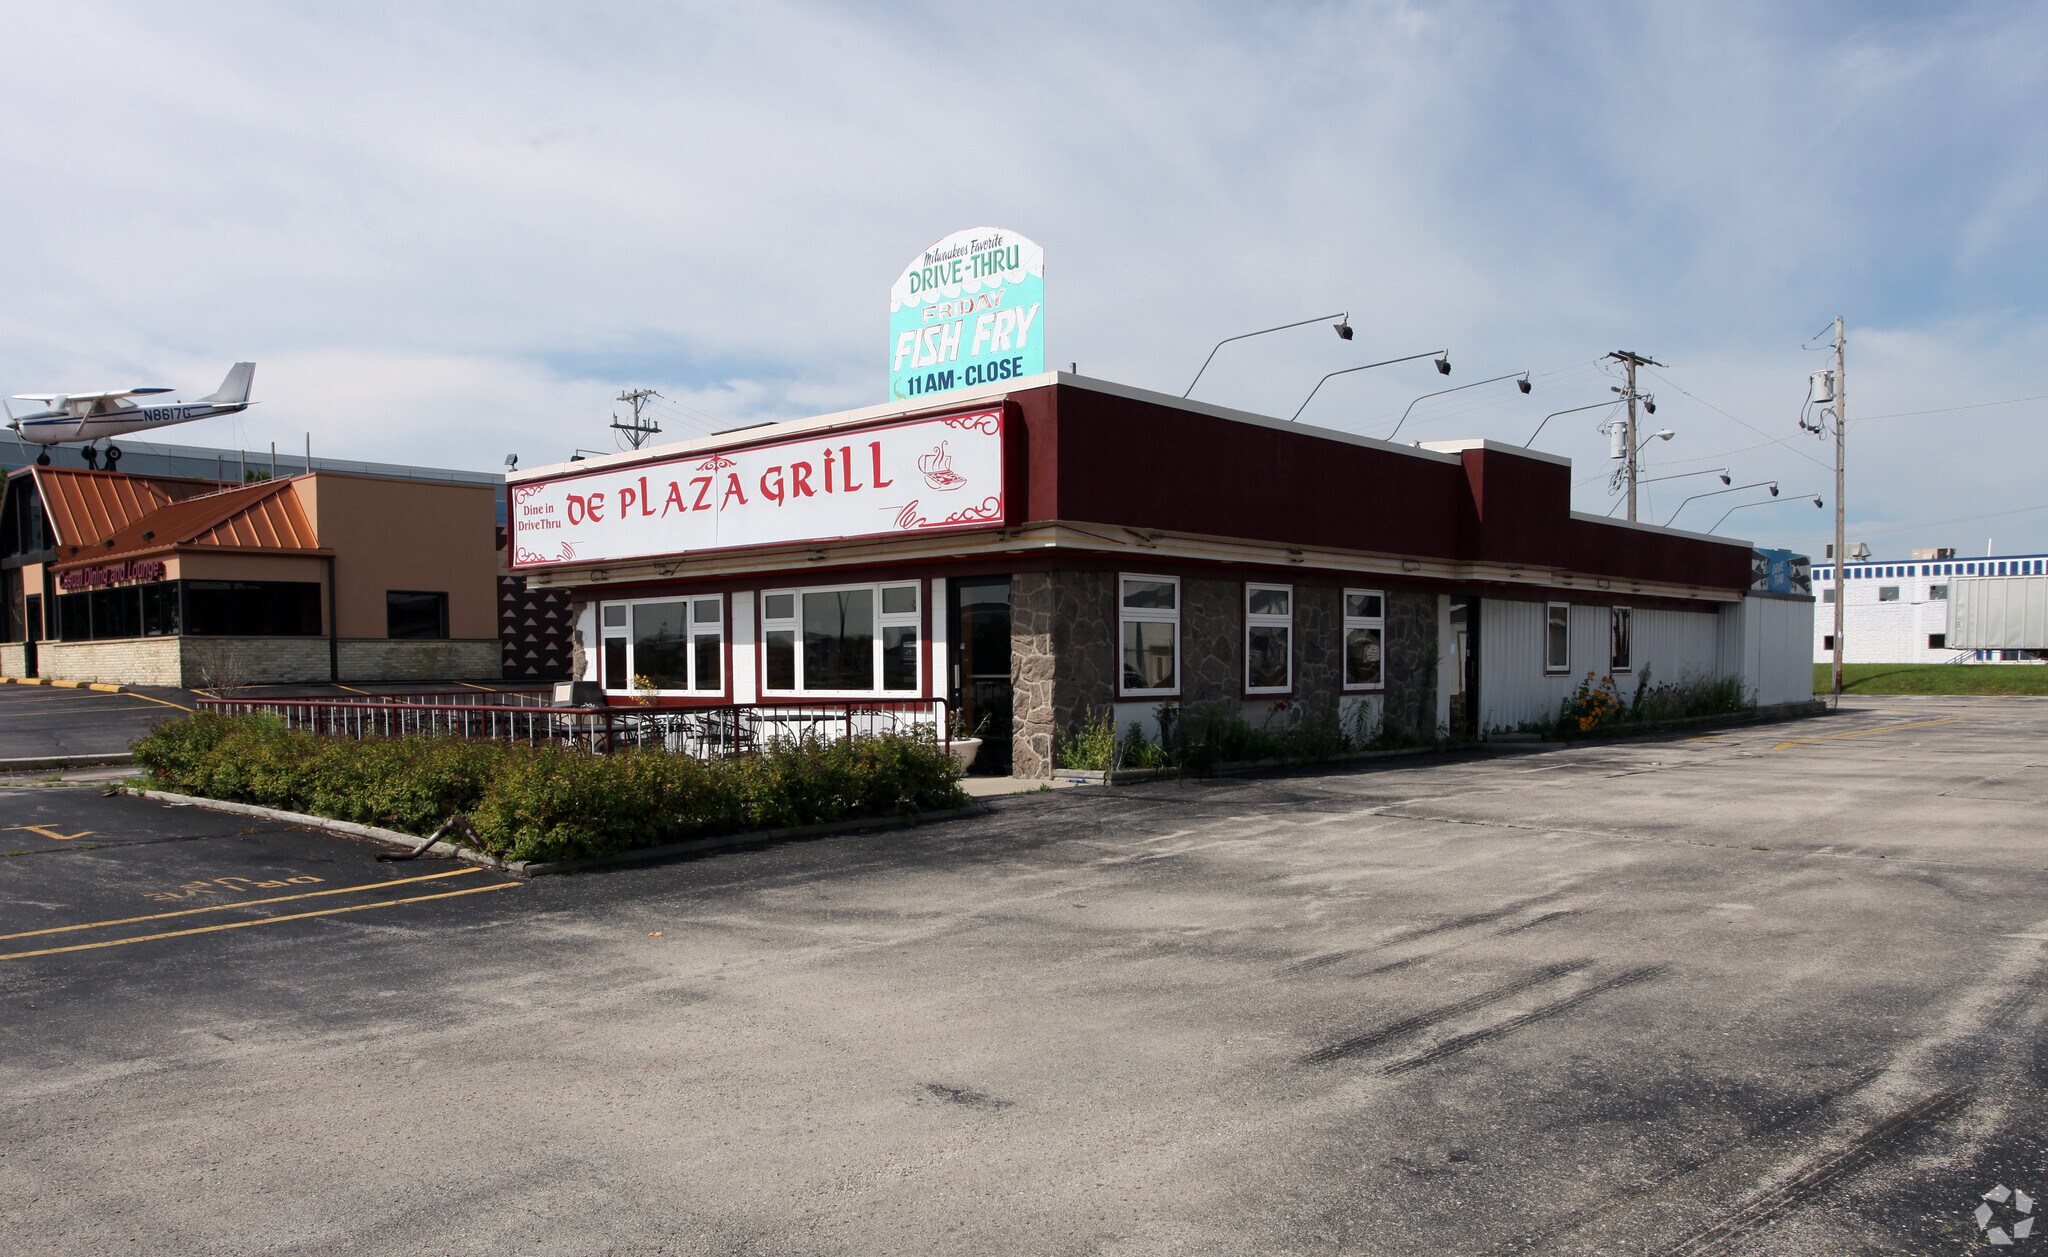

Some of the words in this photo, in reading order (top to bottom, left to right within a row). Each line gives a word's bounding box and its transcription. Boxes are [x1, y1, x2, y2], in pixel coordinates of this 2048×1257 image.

[970, 233, 1004, 255] Favorite
[909, 244, 1019, 294] DRIVE-THRU
[922, 288, 1005, 323] FRIDAY
[893, 320, 963, 372] FISH
[971, 303, 1040, 357] FRY
[144, 407, 191, 422] N8617G
[523, 504, 543, 516] Dine
[545, 503, 554, 514] in
[566, 493, 605, 526] DE
[618, 476, 749, 520] PLAZA
[60, 571, 83, 589] Casual
[84, 566, 108, 587] Dining
[110, 562, 125, 582] and
[128, 561, 159, 580] Lounge
